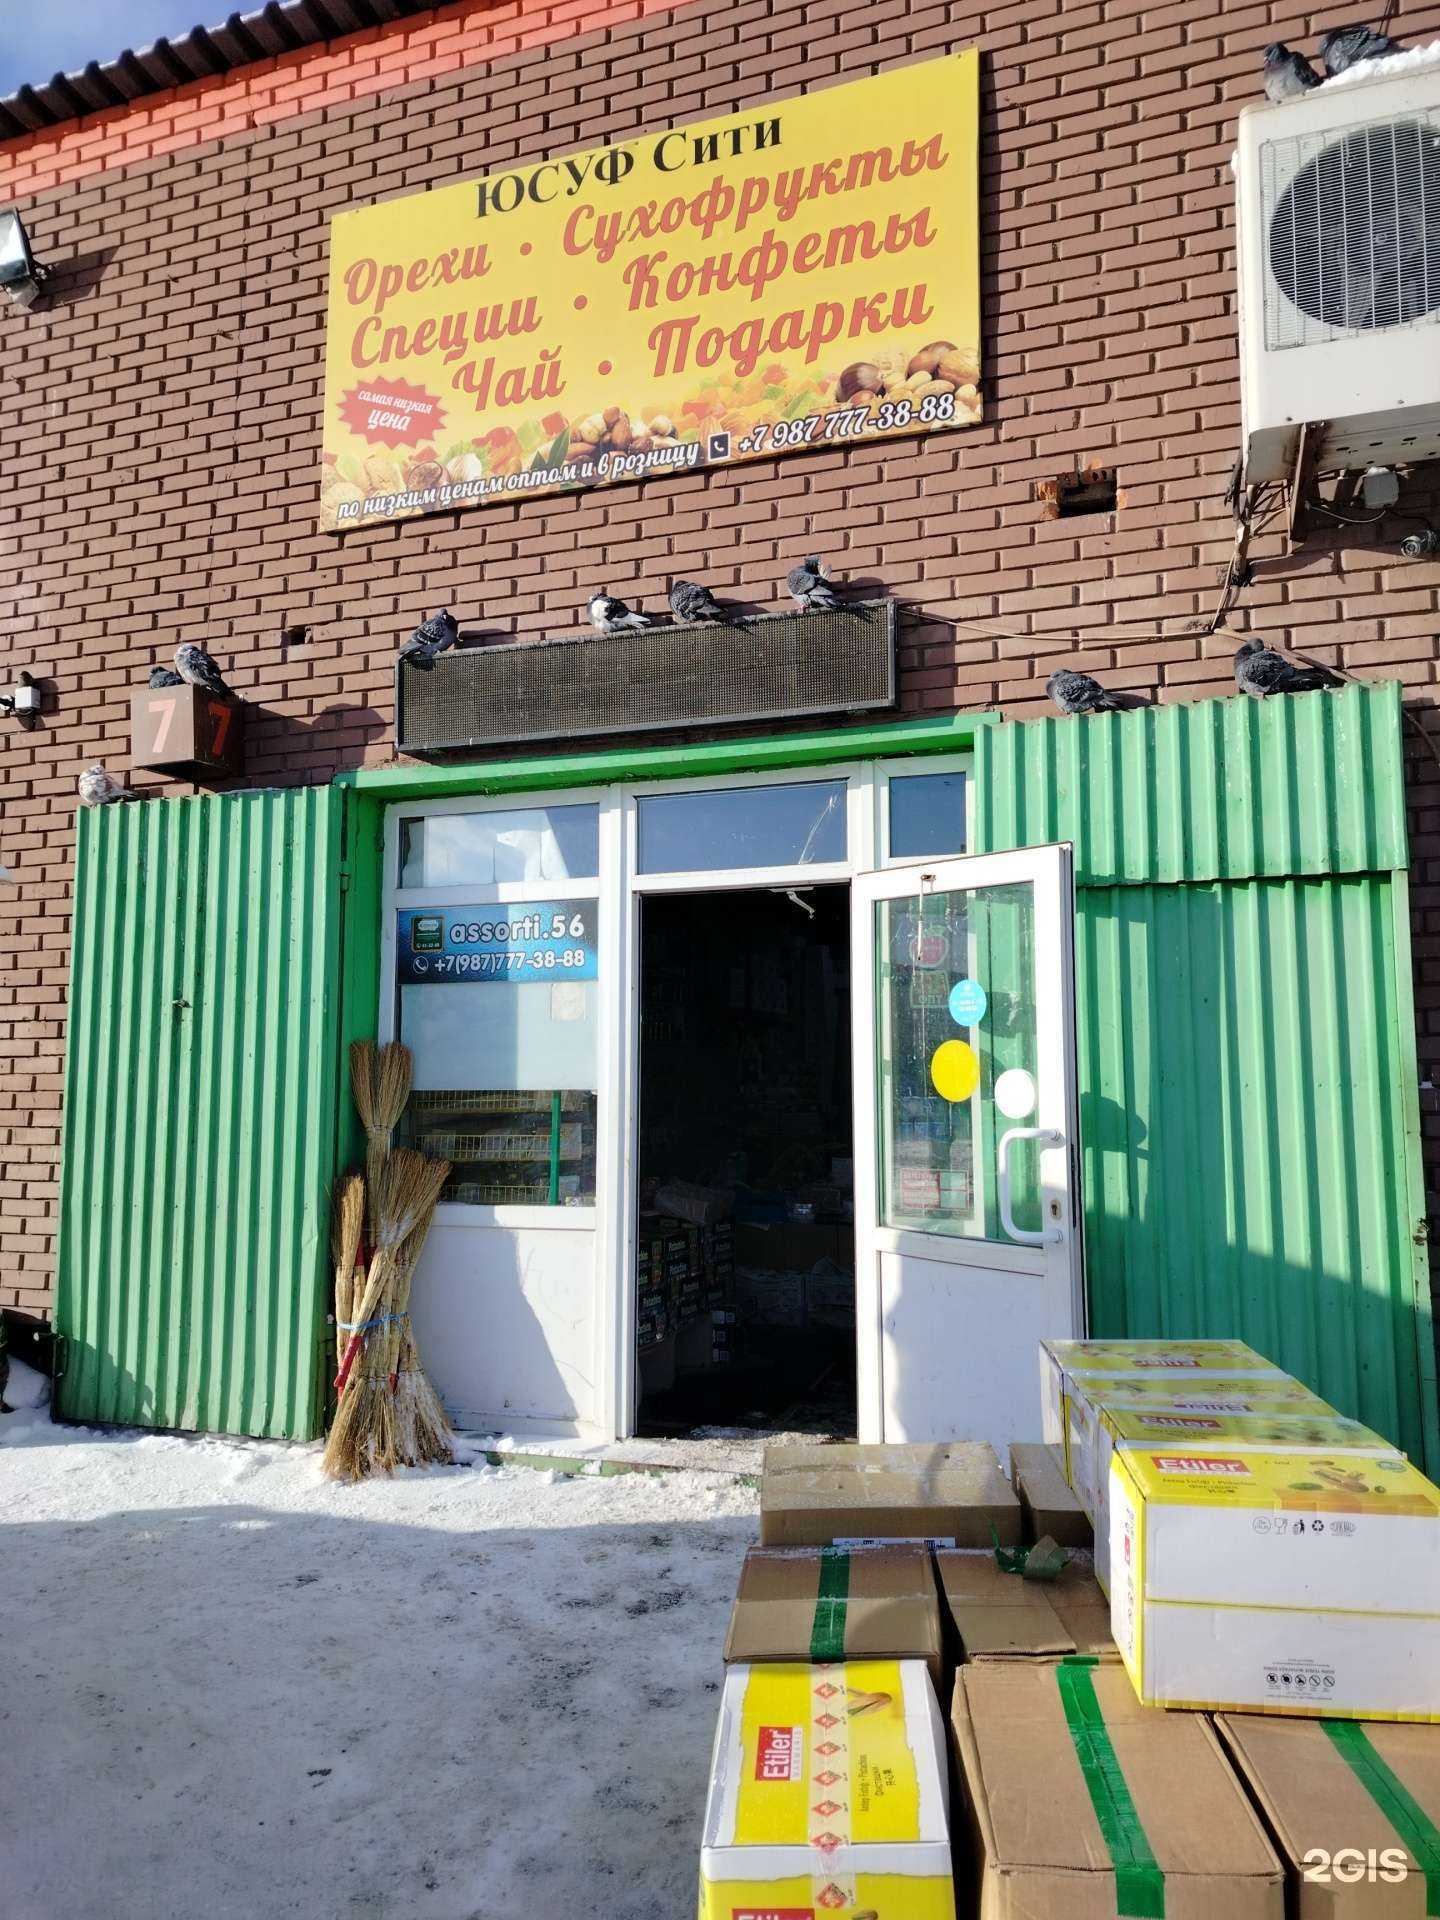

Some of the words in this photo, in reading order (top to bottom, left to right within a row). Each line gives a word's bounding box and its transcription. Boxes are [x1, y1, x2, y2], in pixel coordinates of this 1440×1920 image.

[474, 147, 634, 219] ЮСУФ
[653, 117, 783, 172] Сити
[343, 243, 492, 314] Орехи
[562, 132, 950, 264] Сухофрукты
[350, 295, 543, 369] Специи
[622, 206, 938, 312] Конфеты
[451, 345, 567, 411] Чай
[647, 283, 934, 378] Подарки
[358, 389, 393, 407] самая
[394, 397, 432, 415] низкая
[367, 408, 411, 431] цена
[739, 424, 767, 454] +7
[771, 416, 820, 449] 987
[824, 393, 956, 438] 777-38-88
[337, 500, 360, 520] по
[363, 486, 437, 516] низким
[438, 474, 504, 507] ценам
[507, 463, 578, 492] оптом
[579, 460, 597, 480] и
[597, 452, 610, 476] в
[611, 440, 700, 481] розницу
[149, 699, 176, 753] 7
[207, 700, 232, 758] 7
[450, 913, 585, 944] assorti.56
[434, 949, 585, 974] +7(987)777-38-88
[1159, 1458, 1242, 1473] Etiler
[763, 1729, 792, 1778] Etiler
